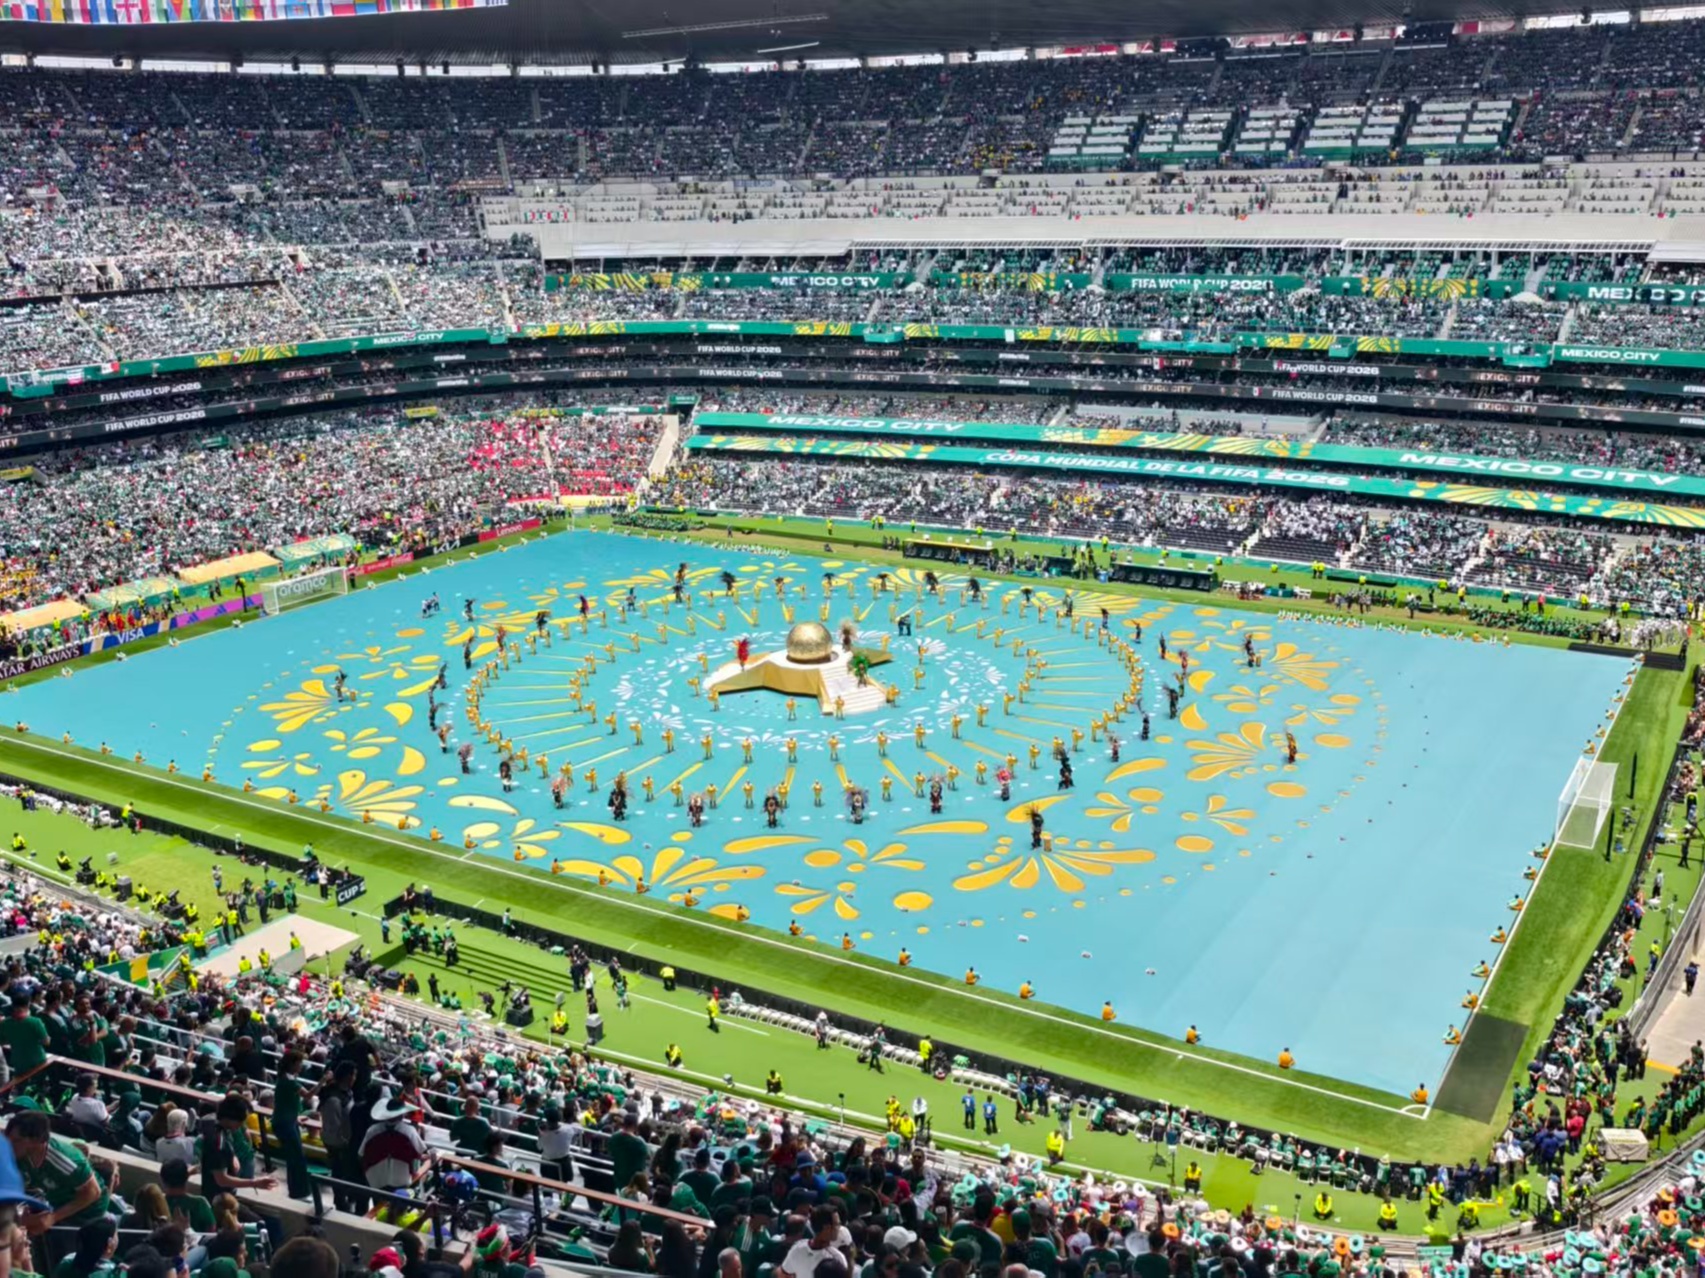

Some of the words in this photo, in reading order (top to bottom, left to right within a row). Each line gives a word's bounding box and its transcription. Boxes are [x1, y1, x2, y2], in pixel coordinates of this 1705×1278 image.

[1131, 278, 1157, 289] FIFA
[418, 332, 443, 341] CITY
[1561, 348, 1620, 360] MEXICO
[1622, 351, 1660, 361] CITY
[1327, 365, 1346, 374] CUP
[1346, 366, 1380, 375] 2026
[101, 393, 120, 402] FIFA
[120, 388, 152, 399] WORLD
[153, 386, 171, 395] CUP
[1272, 390, 1292, 399] FIFA
[1292, 391, 1325, 400] WORLD
[1326, 393, 1344, 401] CUP
[1345, 393, 1378, 403] 2026
[105, 422, 125, 432] FIFA
[125, 417, 158, 428] WORLD
[159, 415, 175, 424] CUP
[176, 410, 206, 421] 2026
[767, 416, 885, 429] MEXICO
[889, 421, 965, 432] CITY
[986, 453, 1042, 465] COPA
[1043, 456, 1139, 471] MUNDIAL
[1143, 461, 1174, 473] DE
[1177, 463, 1206, 475] LA
[1209, 467, 1260, 479] FIFA
[1264, 469, 1351, 487] 2026
[1400, 452, 1562, 476] MEXICO
[1570, 468, 1681, 487] CITY
[496, 524, 523, 537] Lenovo
[279, 575, 327, 597] aramco
[117, 627, 145, 645] VISA
[30, 647, 80, 671] AIRWAYS
[338, 885, 358, 902] CUP
